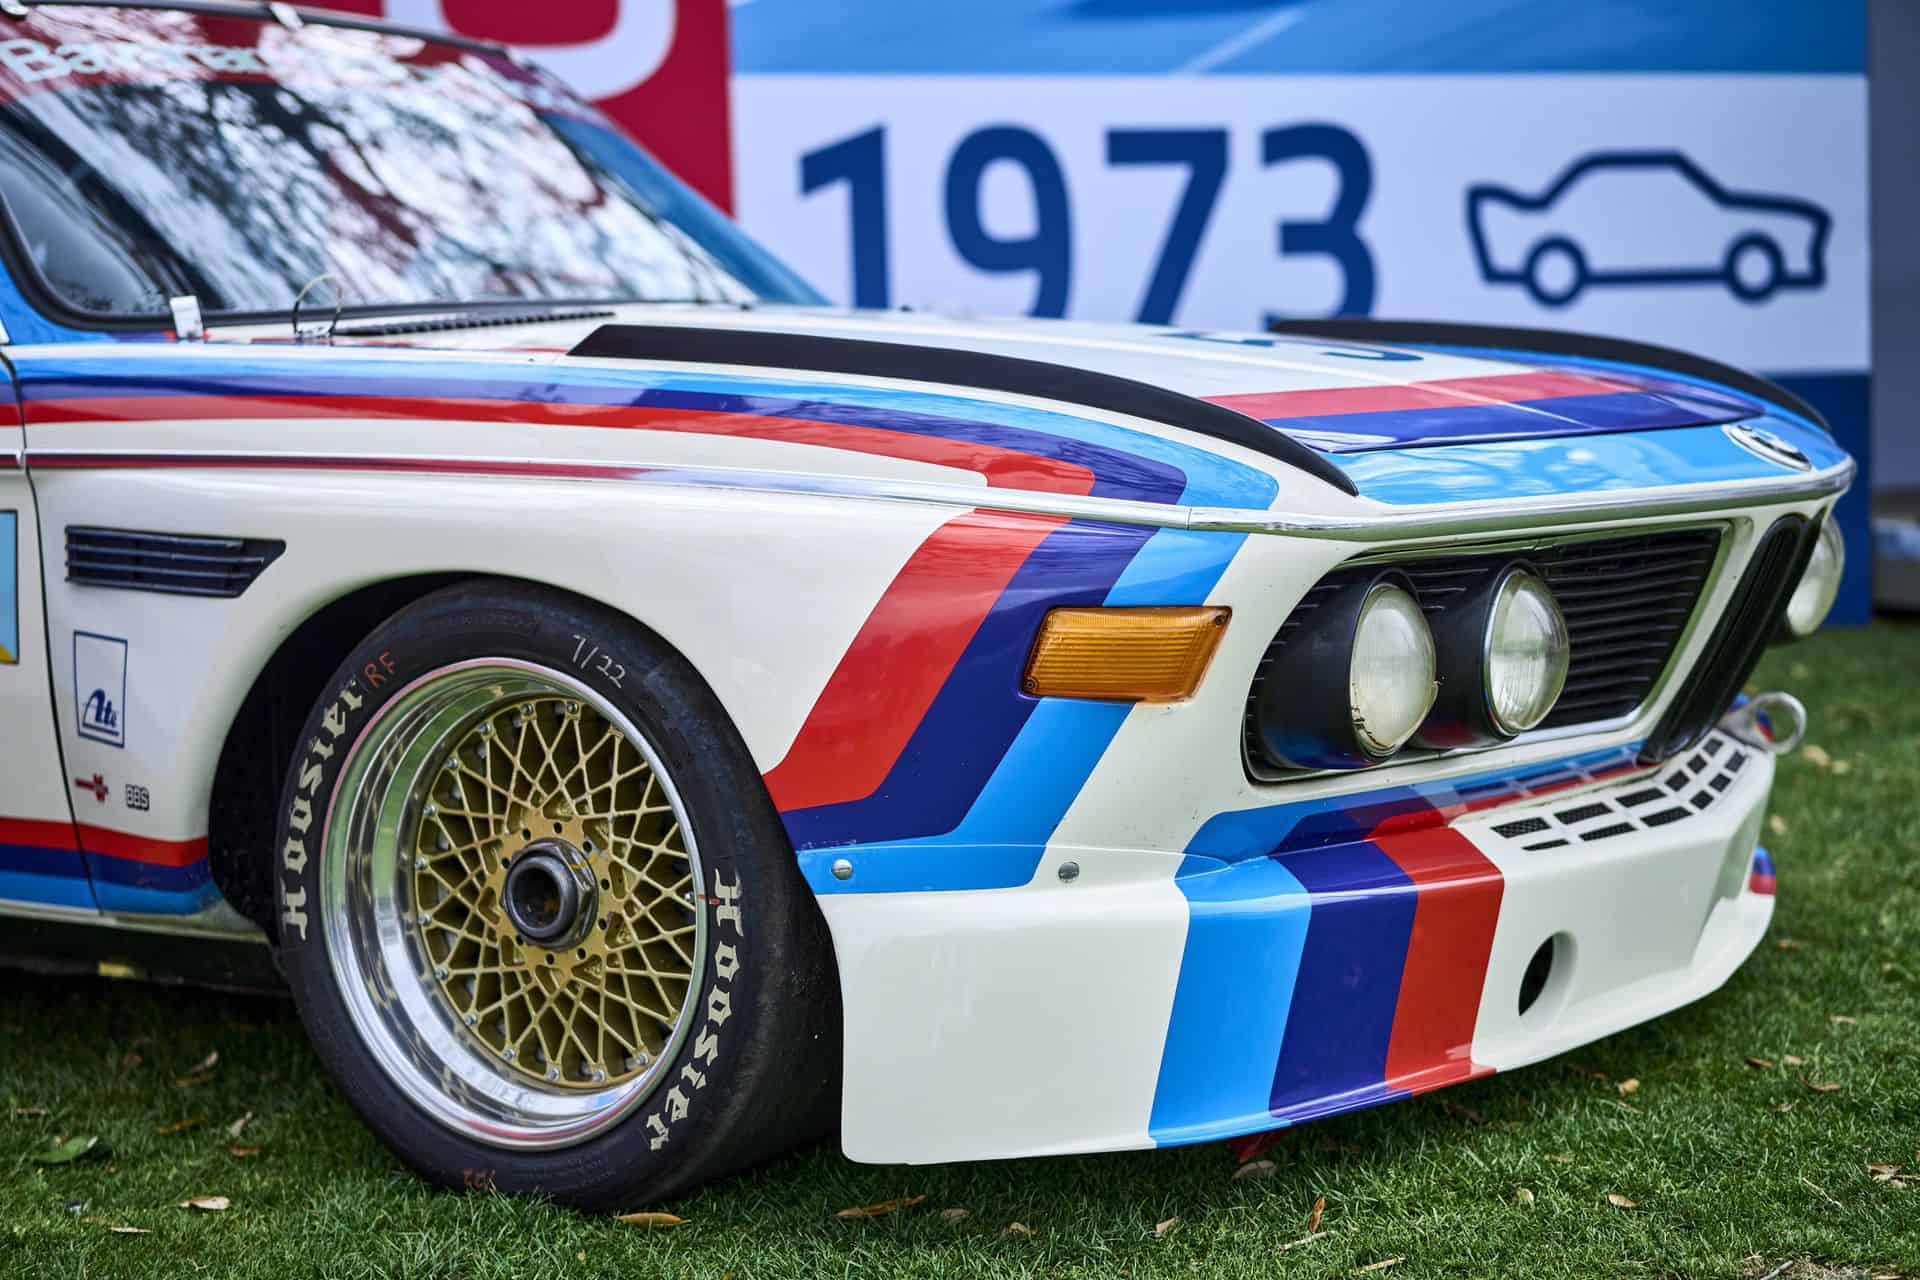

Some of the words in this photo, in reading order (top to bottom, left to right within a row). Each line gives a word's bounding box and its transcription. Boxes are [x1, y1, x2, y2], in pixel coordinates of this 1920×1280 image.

[798, 122, 1378, 332] 1973
[363, 651, 396, 689] RF
[125, 783, 150, 811] BBS
[279, 674, 363, 941] Hoosier
[645, 867, 744, 1151] Hoosier
